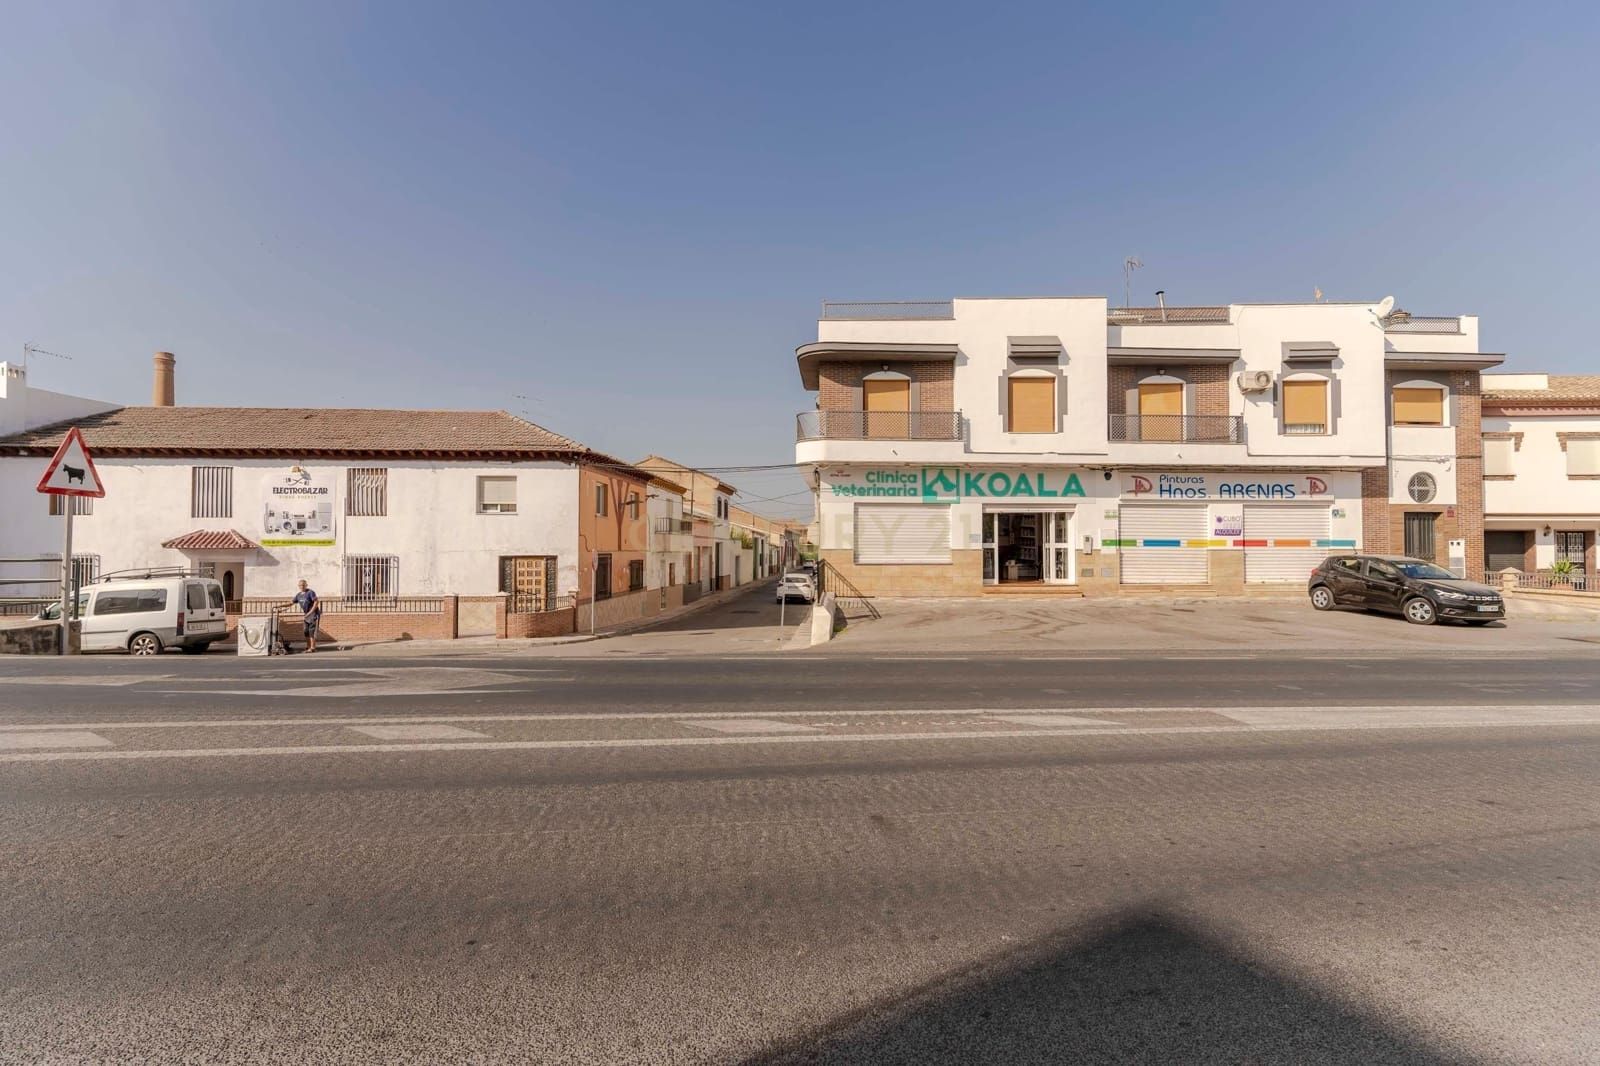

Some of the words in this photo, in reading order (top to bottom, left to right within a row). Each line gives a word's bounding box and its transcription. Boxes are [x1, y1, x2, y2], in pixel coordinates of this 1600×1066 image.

[866, 470, 918, 483] Clínica
[1159, 474, 1205, 484] Pinturas
[272, 487, 329, 495] ELECTROBAZAR
[832, 483, 918, 497] Veterinaria
[965, 472, 1086, 497] KOALA
[1159, 483, 1212, 499] Hnos.
[1219, 483, 1296, 499] ARENAS
